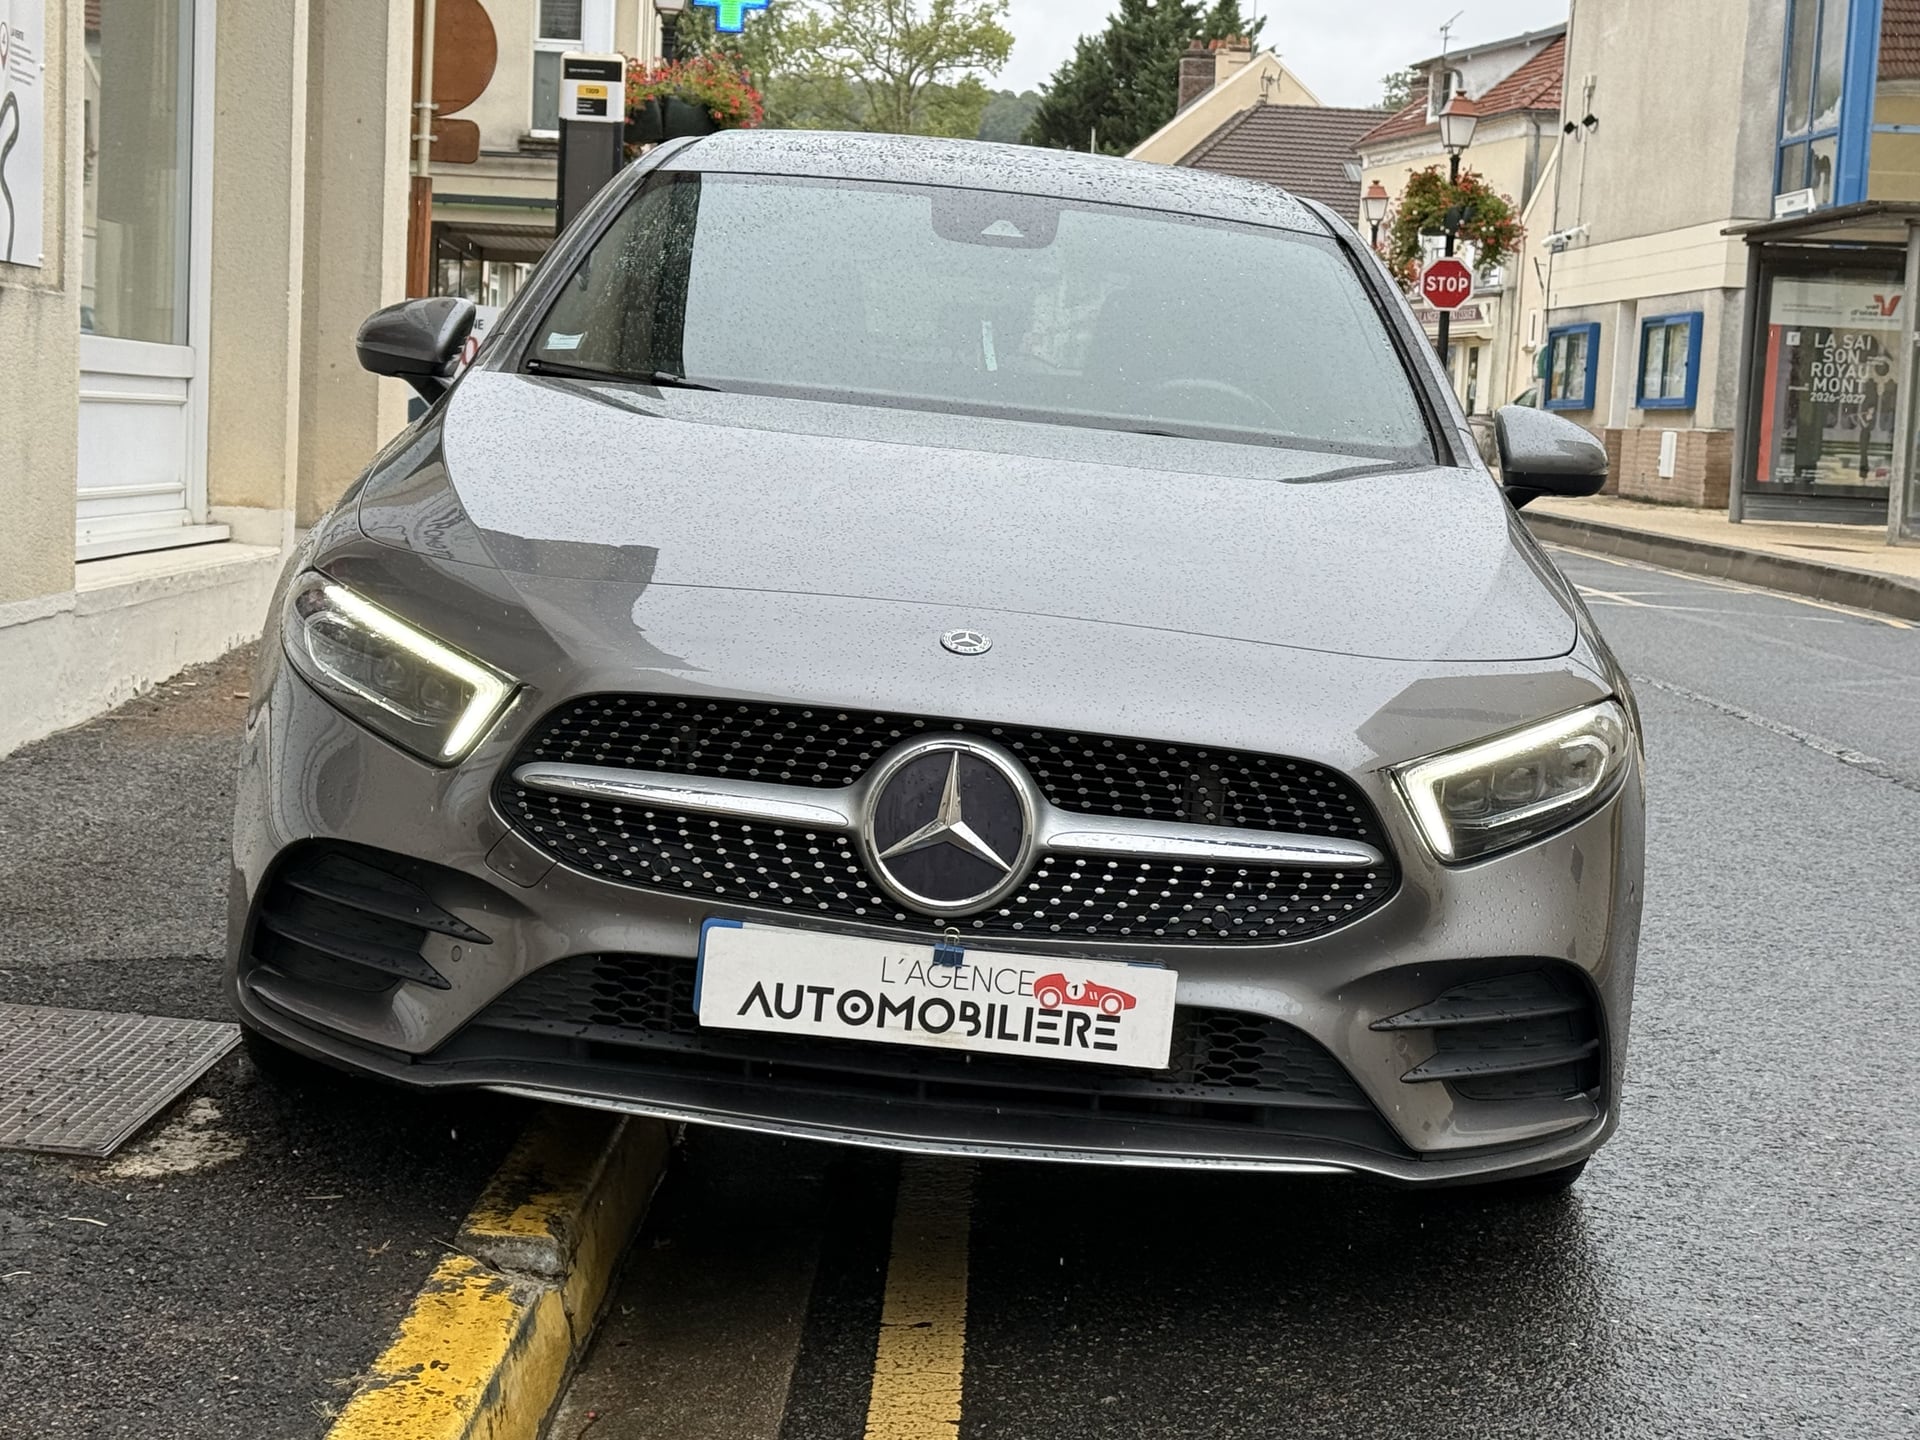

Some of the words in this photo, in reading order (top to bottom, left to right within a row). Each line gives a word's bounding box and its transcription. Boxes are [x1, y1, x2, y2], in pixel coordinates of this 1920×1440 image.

[1426, 275, 1469, 293] STOP
[1814, 332, 1836, 348] LA
[1843, 334, 1872, 351] SAI
[1822, 348, 1860, 364] SON
[1811, 361, 1870, 380] ROYAU
[1813, 377, 1867, 394] MONT
[1810, 391, 1866, 404] 2026-2027
[881, 956, 1036, 997] L'AGENCE
[736, 980, 1121, 1051] AUTOMOBILIERE
